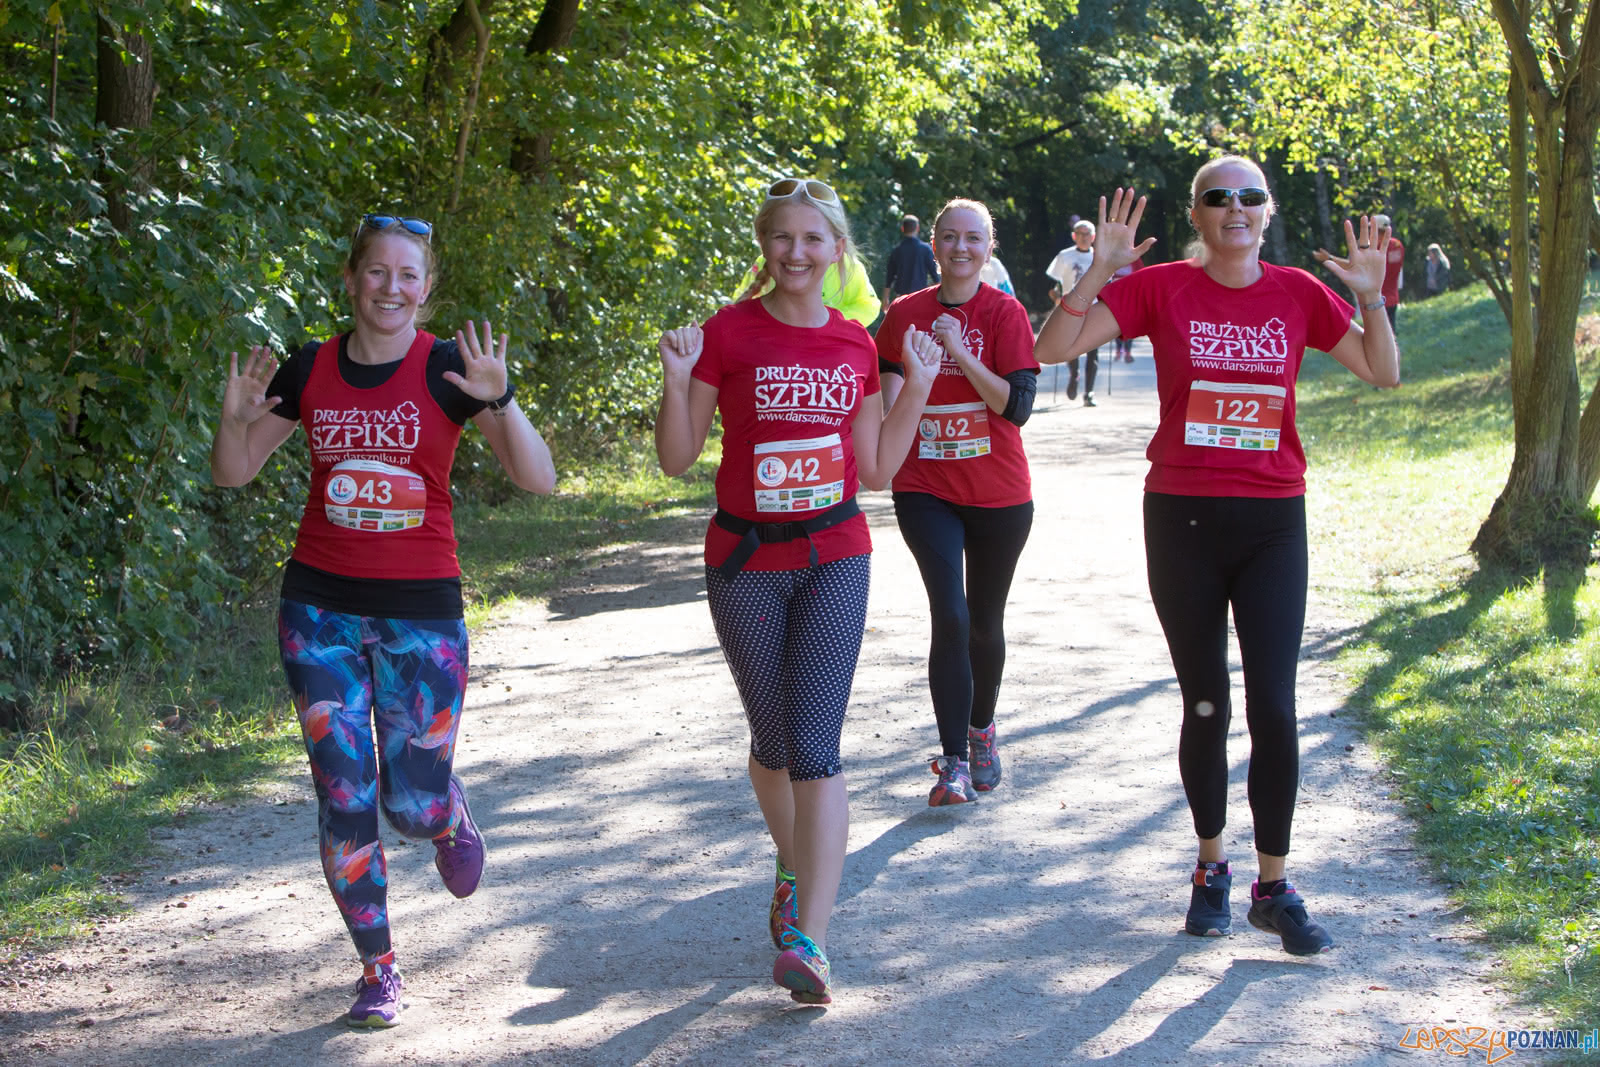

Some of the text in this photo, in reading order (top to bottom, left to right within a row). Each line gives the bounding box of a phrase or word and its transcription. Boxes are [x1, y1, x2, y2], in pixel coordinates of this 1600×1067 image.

[1190, 321, 1271, 339] DRUŻYNA
[1190, 337, 1288, 359] SZPIKU
[755, 363, 843, 384] DRUŻYNA
[1191, 359, 1285, 375] www.darszpiku.pl
[755, 382, 858, 411] SZPIKU
[312, 407, 401, 424] DRUŻYNA
[1215, 399, 1260, 423] 122
[311, 423, 421, 450] SZPIKU
[935, 417, 970, 439] 162
[788, 457, 821, 482] 42
[358, 480, 393, 504] 43
